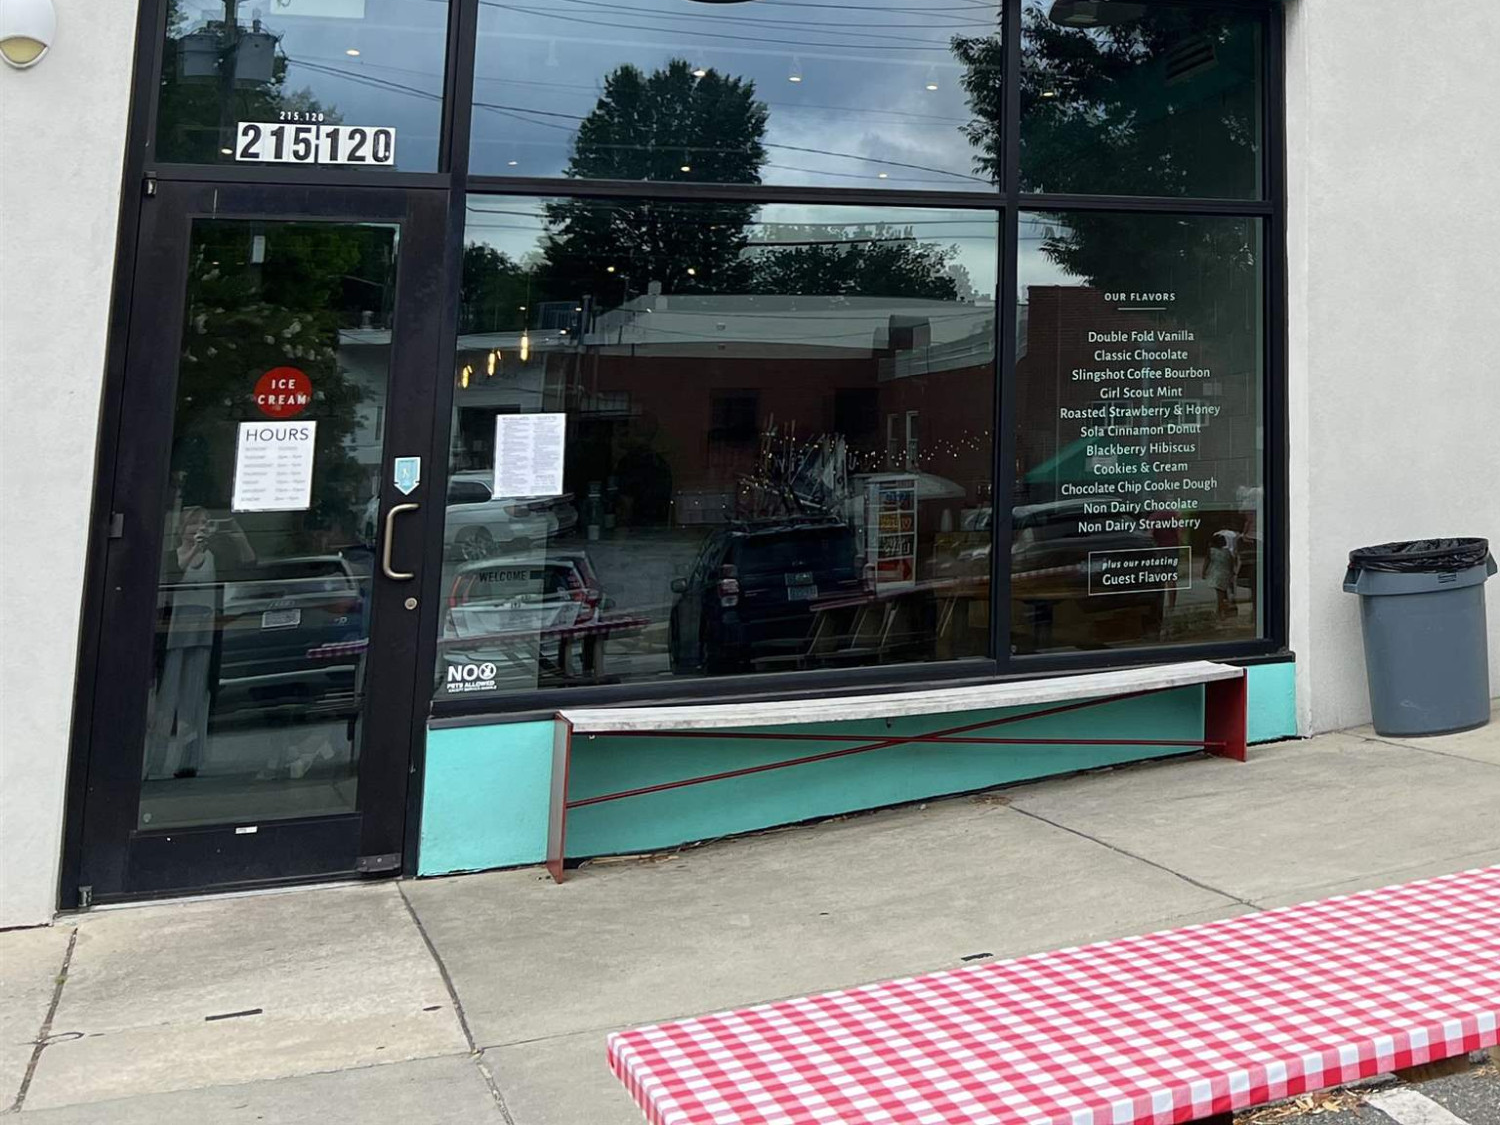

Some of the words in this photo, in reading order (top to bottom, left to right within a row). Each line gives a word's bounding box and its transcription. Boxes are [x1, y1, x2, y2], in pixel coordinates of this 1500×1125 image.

[1104, 292, 1126, 301] OUR
[1130, 292, 1176, 301] FLAVORS
[1088, 331, 1128, 342] Double
[1131, 331, 1154, 342] Fold
[1157, 330, 1195, 341] Vanilla
[1094, 350, 1132, 361] Classic
[1134, 349, 1188, 360] Chocolate
[1072, 368, 1125, 382] Slingshot
[1127, 367, 1162, 379] Coffee
[1164, 367, 1210, 378] Bourbon
[271, 379, 296, 389] ICE
[1100, 387, 1120, 398] Girl
[1123, 387, 1154, 398] Scout
[1157, 386, 1182, 396] Mint
[257, 394, 307, 405] CREAM
[1060, 406, 1106, 418] Roasted
[1109, 405, 1170, 418] Strawberry
[1174, 404, 1182, 415] &
[1186, 404, 1221, 416] Honey
[246, 428, 309, 442] HOURS
[1080, 426, 1105, 437] Sola
[1108, 425, 1164, 436] Cinnamon
[1167, 424, 1201, 435] Donut
[1087, 443, 1147, 456] Blackberry
[1150, 443, 1196, 454] Hibiscus
[1094, 463, 1137, 475] Cookies
[1140, 462, 1150, 473] &
[1153, 461, 1188, 473] Cream
[1061, 481, 1115, 495] Chocolate
[1118, 481, 1142, 494] Chip
[1144, 478, 1180, 491] Cookie
[1183, 477, 1218, 491] Dough
[1084, 503, 1107, 514] Non
[1111, 501, 1141, 514] Dairy
[1144, 498, 1198, 511] Chocolate
[1078, 522, 1102, 533] Non
[1106, 519, 1136, 533] Dairy
[1139, 517, 1201, 530] Strawberry
[1101, 559, 1121, 570] plus
[1123, 560, 1139, 568] our
[1141, 556, 1179, 567] rotating
[480, 570, 529, 583] WELCOME
[1102, 574, 1136, 585] Guest
[1138, 571, 1178, 583] Flavors
[447, 664, 478, 682] NO
